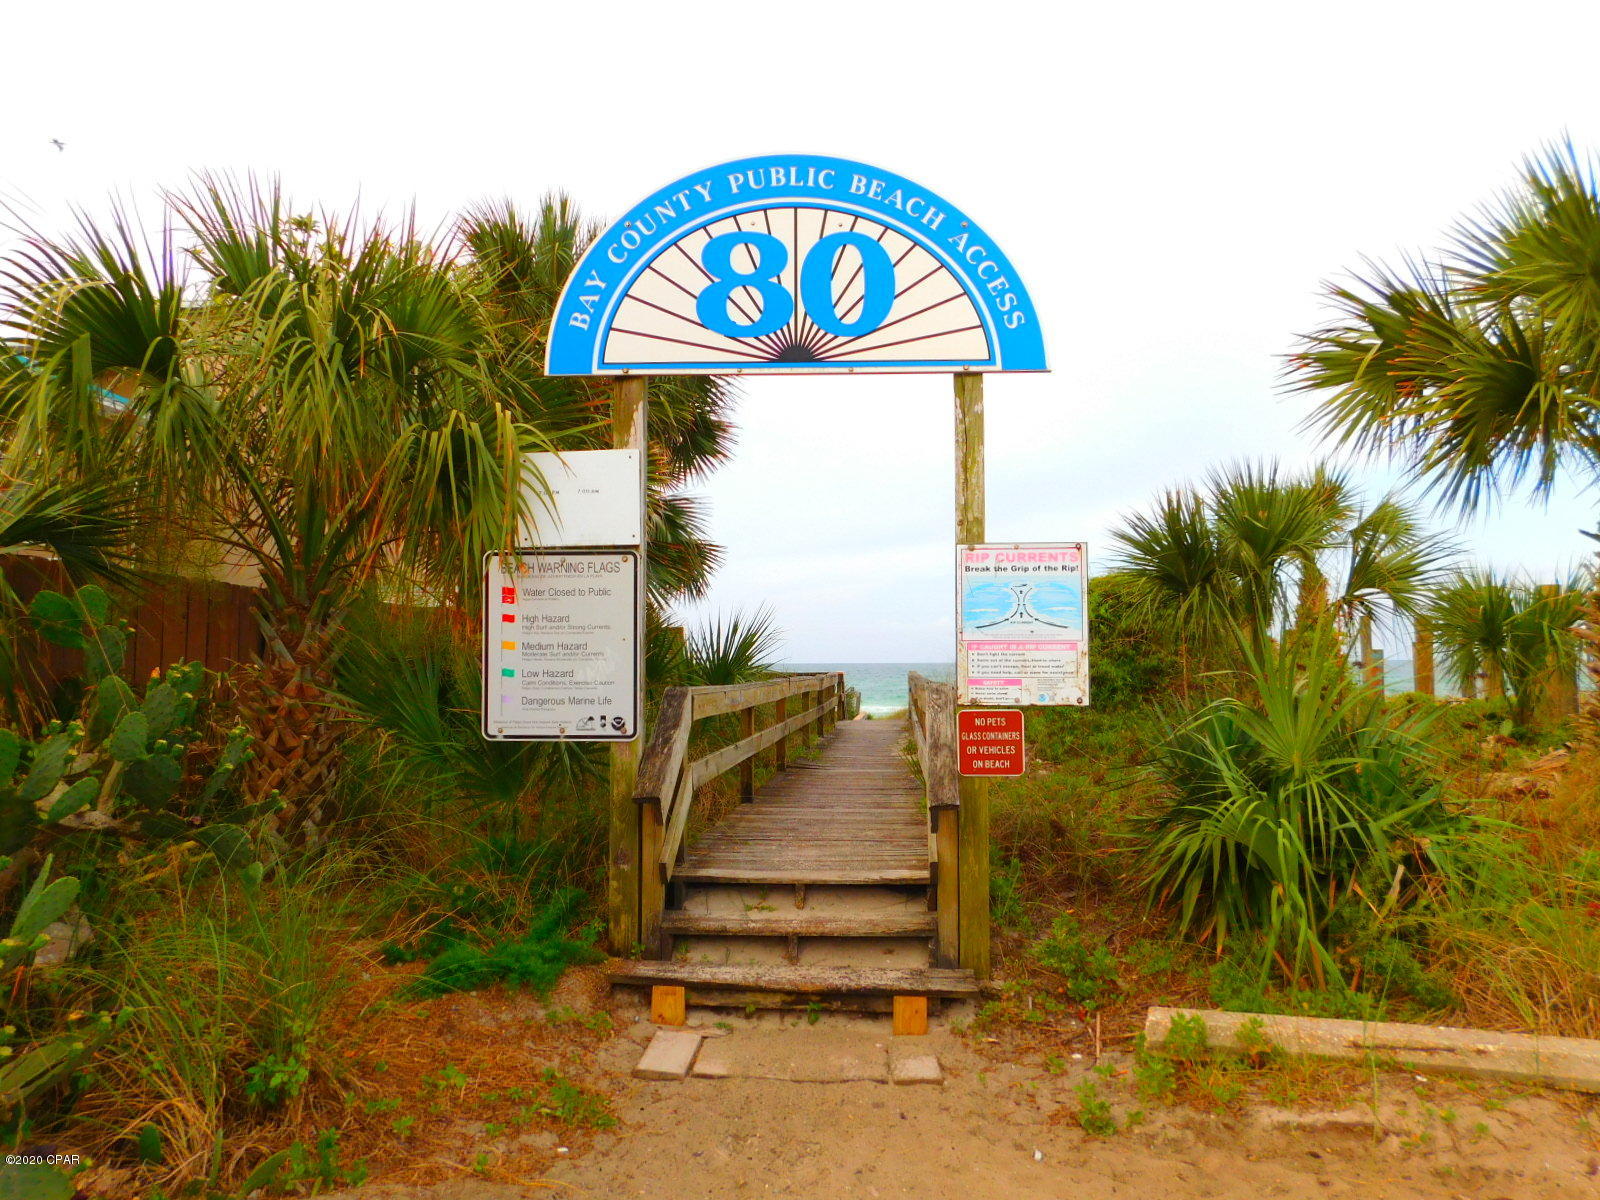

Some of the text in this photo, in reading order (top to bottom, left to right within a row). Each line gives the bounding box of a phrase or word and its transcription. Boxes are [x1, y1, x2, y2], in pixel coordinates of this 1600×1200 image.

[569, 166, 1025, 331] BAY COUNTY PUBLIC BEACH ACCESS
[696, 231, 896, 338] 80
[964, 552, 1079, 563] RIP CURRENTS
[539, 562, 585, 574] WARNING
[587, 561, 621, 574] FLAGS
[965, 565, 1079, 573] Break the Grip of the Rip!
[522, 587, 612, 597] Water Closed to Public
[522, 614, 570, 624] High Hazard
[521, 642, 588, 651] Medium Hazard
[521, 669, 574, 678] Low Hazard
[521, 696, 612, 707] Dangerous Marine Life
[975, 717, 1006, 727] NO PETS
[961, 731, 1020, 741] GLASS CONTAINERS
[966, 745, 1016, 755] OR VEHICLES
[972, 759, 1010, 769] ON BEACH
